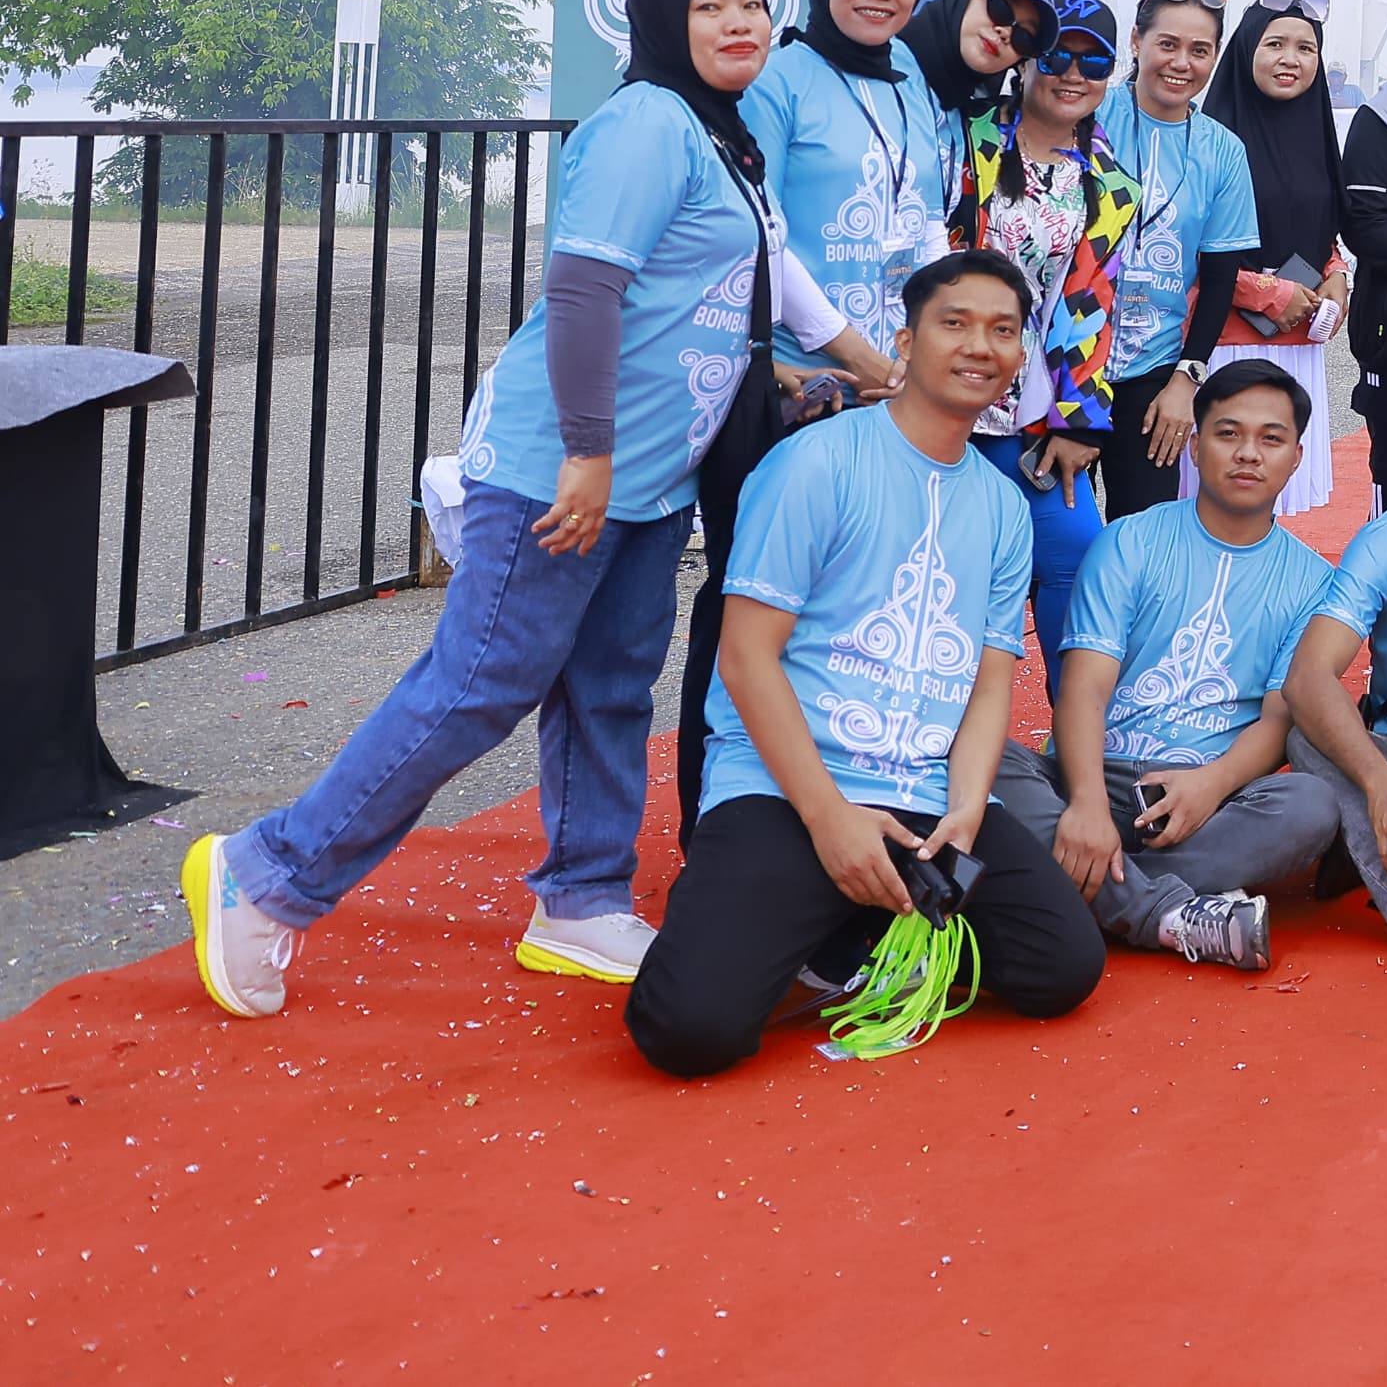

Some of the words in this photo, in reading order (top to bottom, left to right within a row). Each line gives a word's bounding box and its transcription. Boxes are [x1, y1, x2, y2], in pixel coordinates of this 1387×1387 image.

[1150, 273, 1184, 294] RLARI
[692, 305, 748, 333] BOMBA
[827, 652, 915, 693] BOMBANA
[920, 674, 972, 705] BERLAR
[1135, 719, 1179, 740] 025
[1164, 706, 1232, 733] BERLARI
